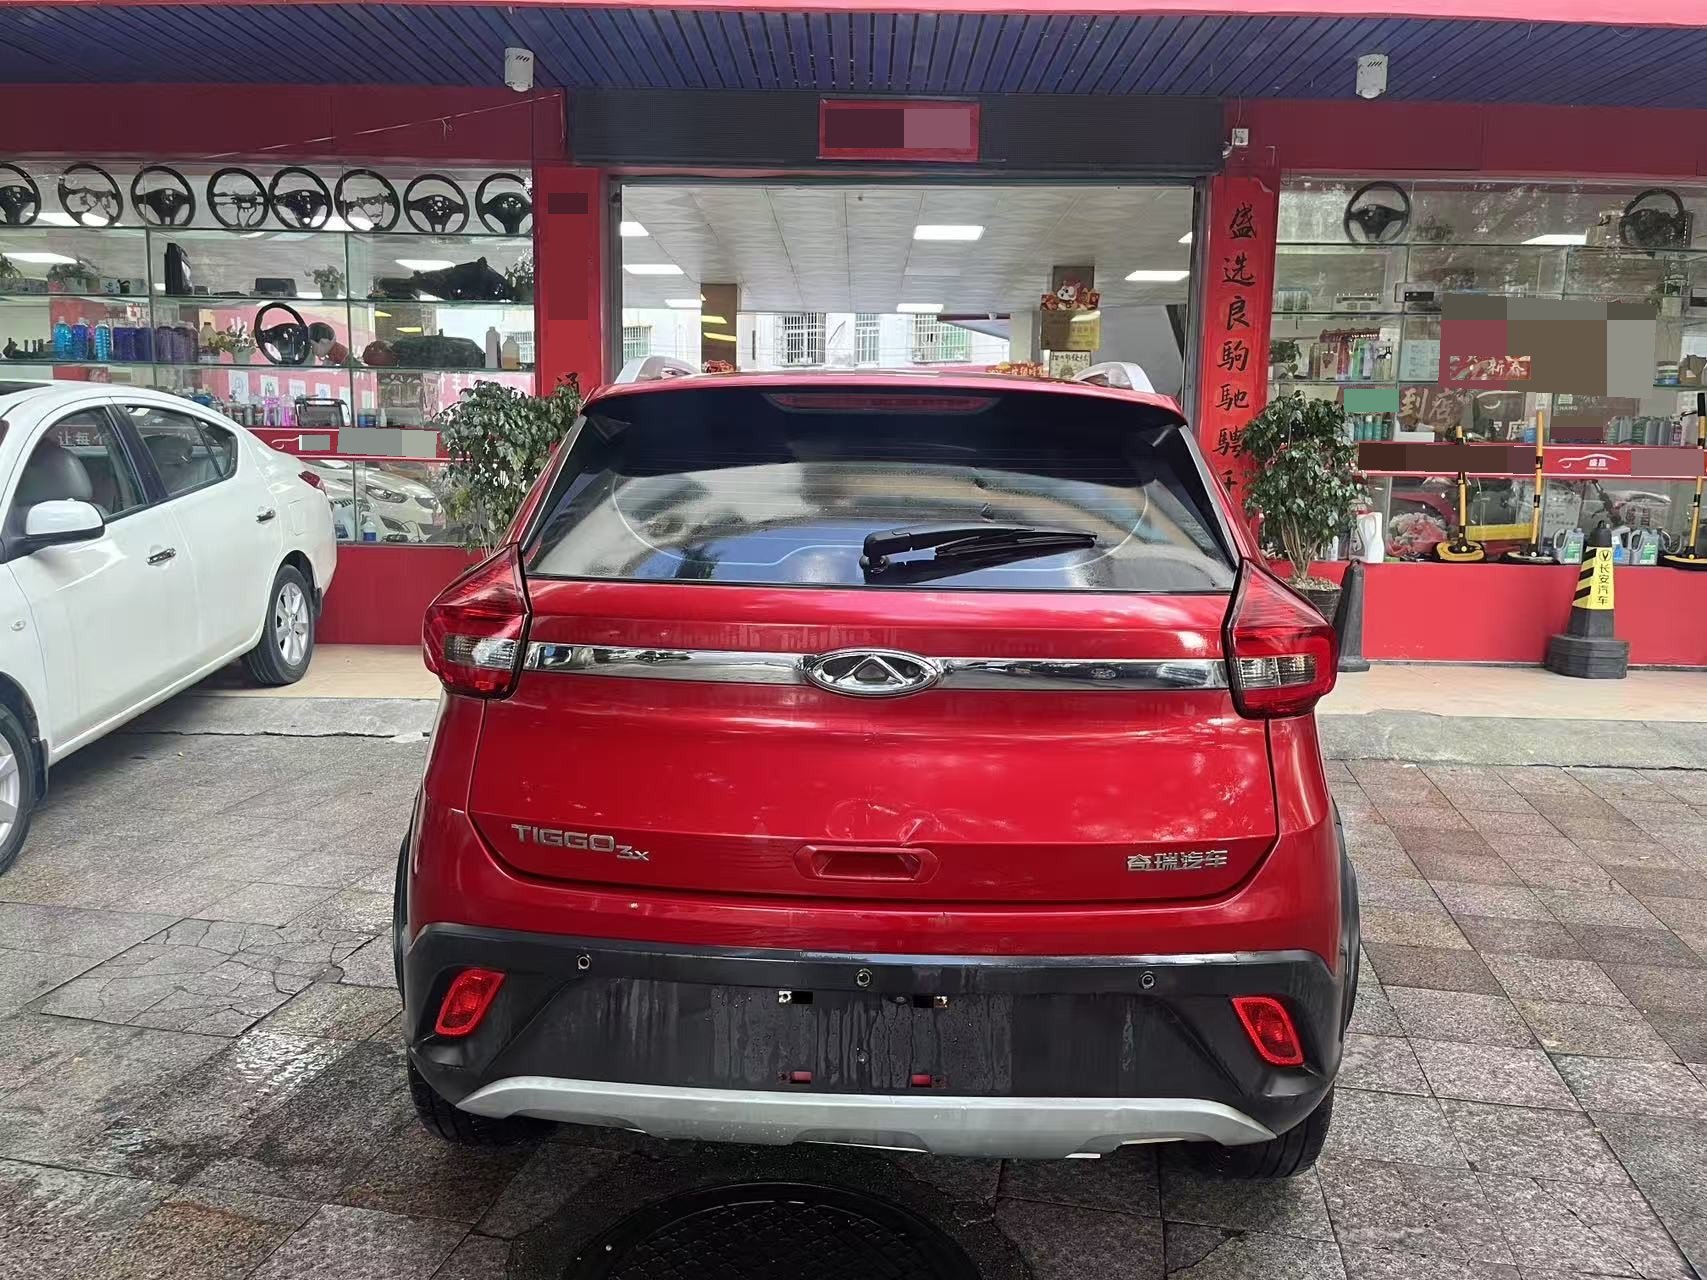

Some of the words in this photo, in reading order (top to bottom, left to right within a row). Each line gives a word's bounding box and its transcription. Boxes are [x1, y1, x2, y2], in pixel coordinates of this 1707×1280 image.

[1597, 563, 1611, 606] 长安汽车
[511, 823, 615, 853] TIGGO
[1127, 850, 1228, 872] 奇瑞汽车
